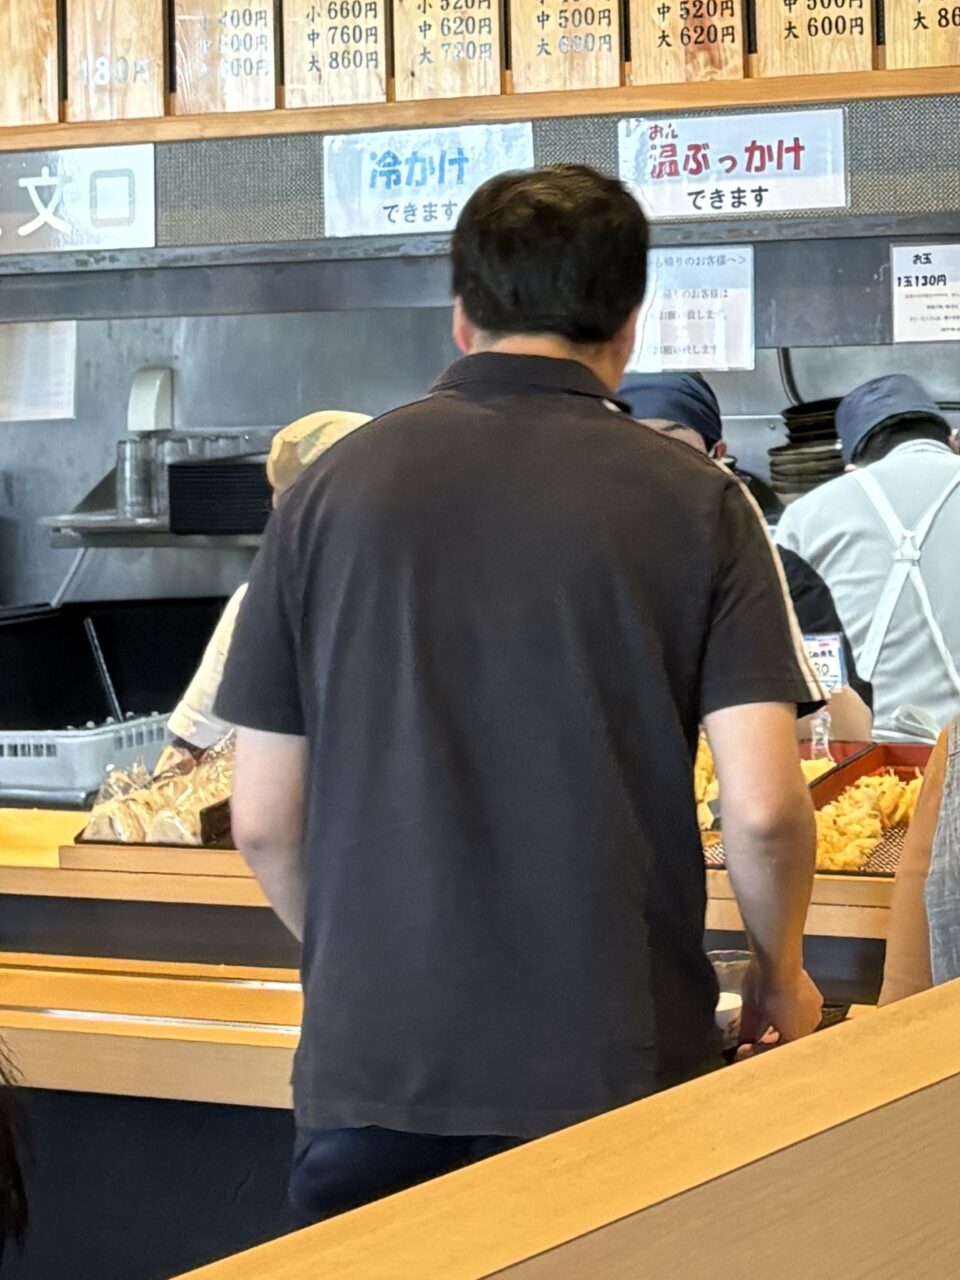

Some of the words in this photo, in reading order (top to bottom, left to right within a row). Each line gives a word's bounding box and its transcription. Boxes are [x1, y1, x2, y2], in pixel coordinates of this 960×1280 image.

[306, 5, 321, 23] 小
[327, 0, 378, 21] 660円
[536, 10, 551, 30] 中
[558, 7, 611, 28] 500円
[657, 2, 671, 22] 中
[912, 11, 929, 31] 大
[307, 27, 320, 48] 中
[327, 25, 378, 46] 760円
[418, 20, 432, 40] 中
[440, 15, 491, 37] 620円
[657, 30, 672, 49] 大
[680, 24, 736, 46] 620円
[783, 21, 799, 40] 大
[807, 15, 864, 37] 600円
[418, 46, 434, 65] 大
[536, 37, 552, 56] 大
[307, 55, 321, 73] 大
[328, 49, 379, 71] 860円
[369, 147, 469, 189] 冷かけ
[650, 137, 805, 179] 温ぶっかけ
[0, 166, 136, 236] 文口
[687, 186, 769, 210] できます
[382, 200, 458, 224] できます
[897, 274, 947, 287] 1玉130円
